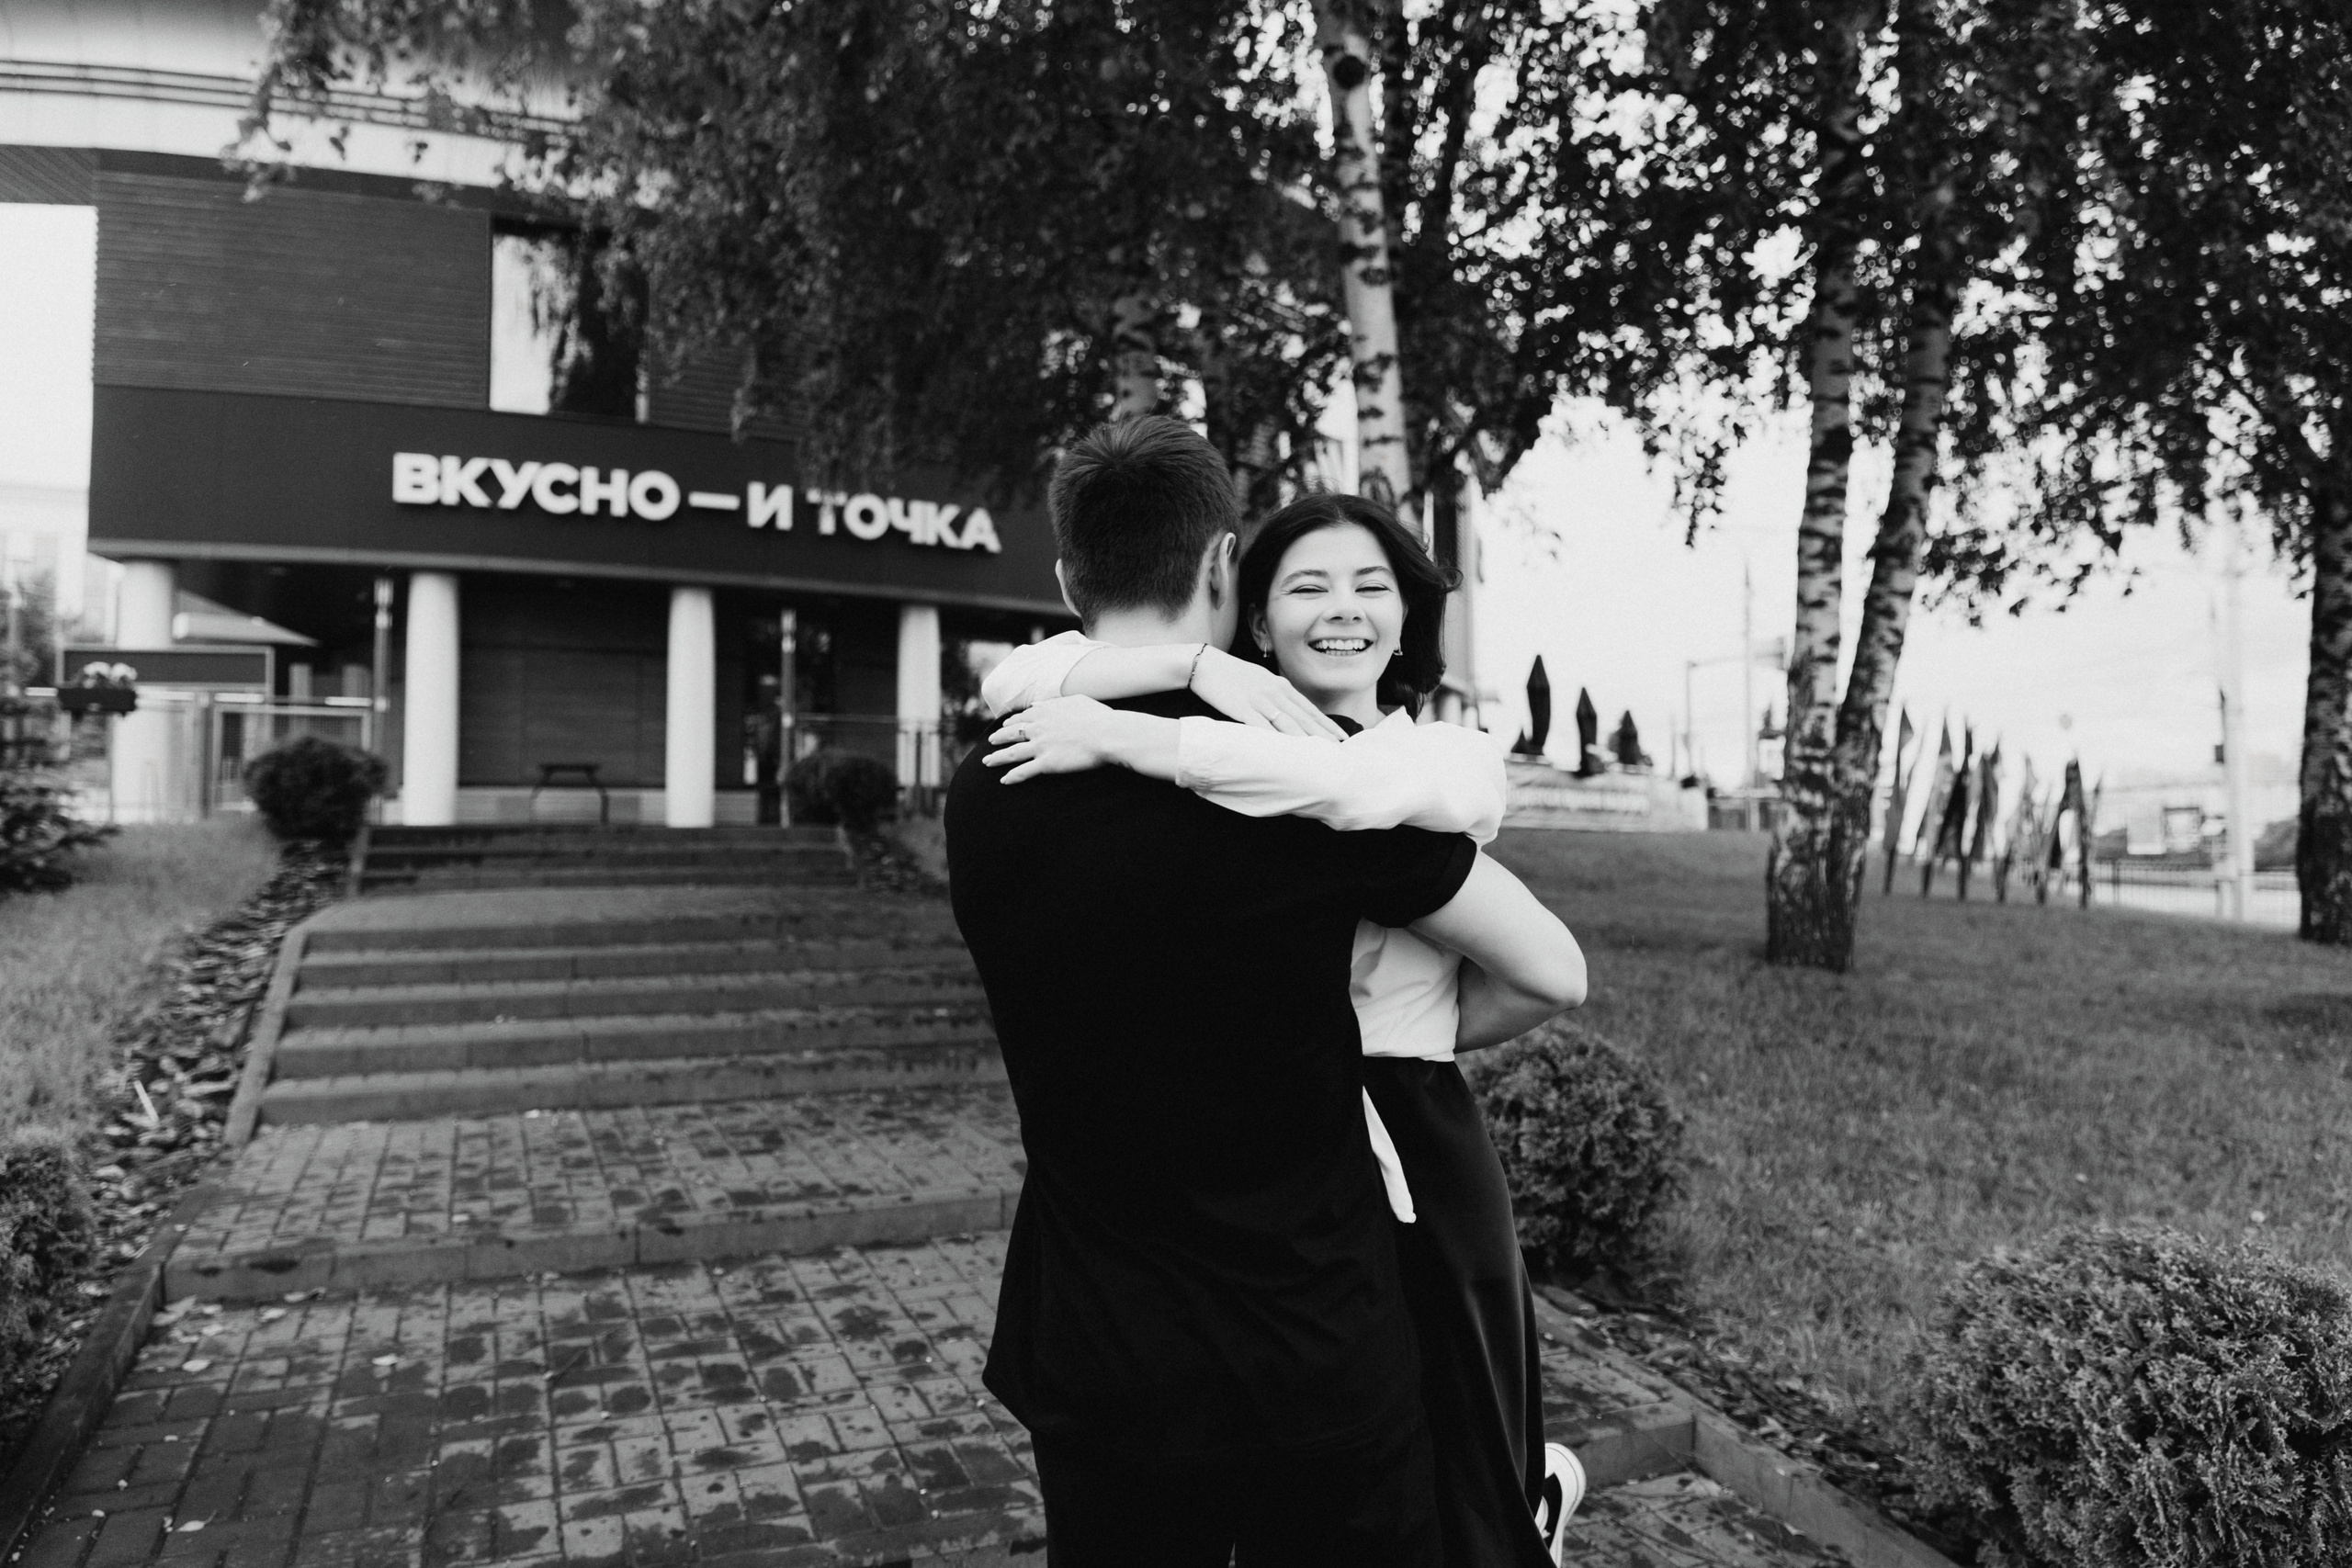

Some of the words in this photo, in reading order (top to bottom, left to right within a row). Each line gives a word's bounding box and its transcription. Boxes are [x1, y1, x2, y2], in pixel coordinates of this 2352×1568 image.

[392, 452, 681, 521] ВКУСНО
[747, 481, 793, 530] И
[806, 488, 1002, 553] ТОЧКА
